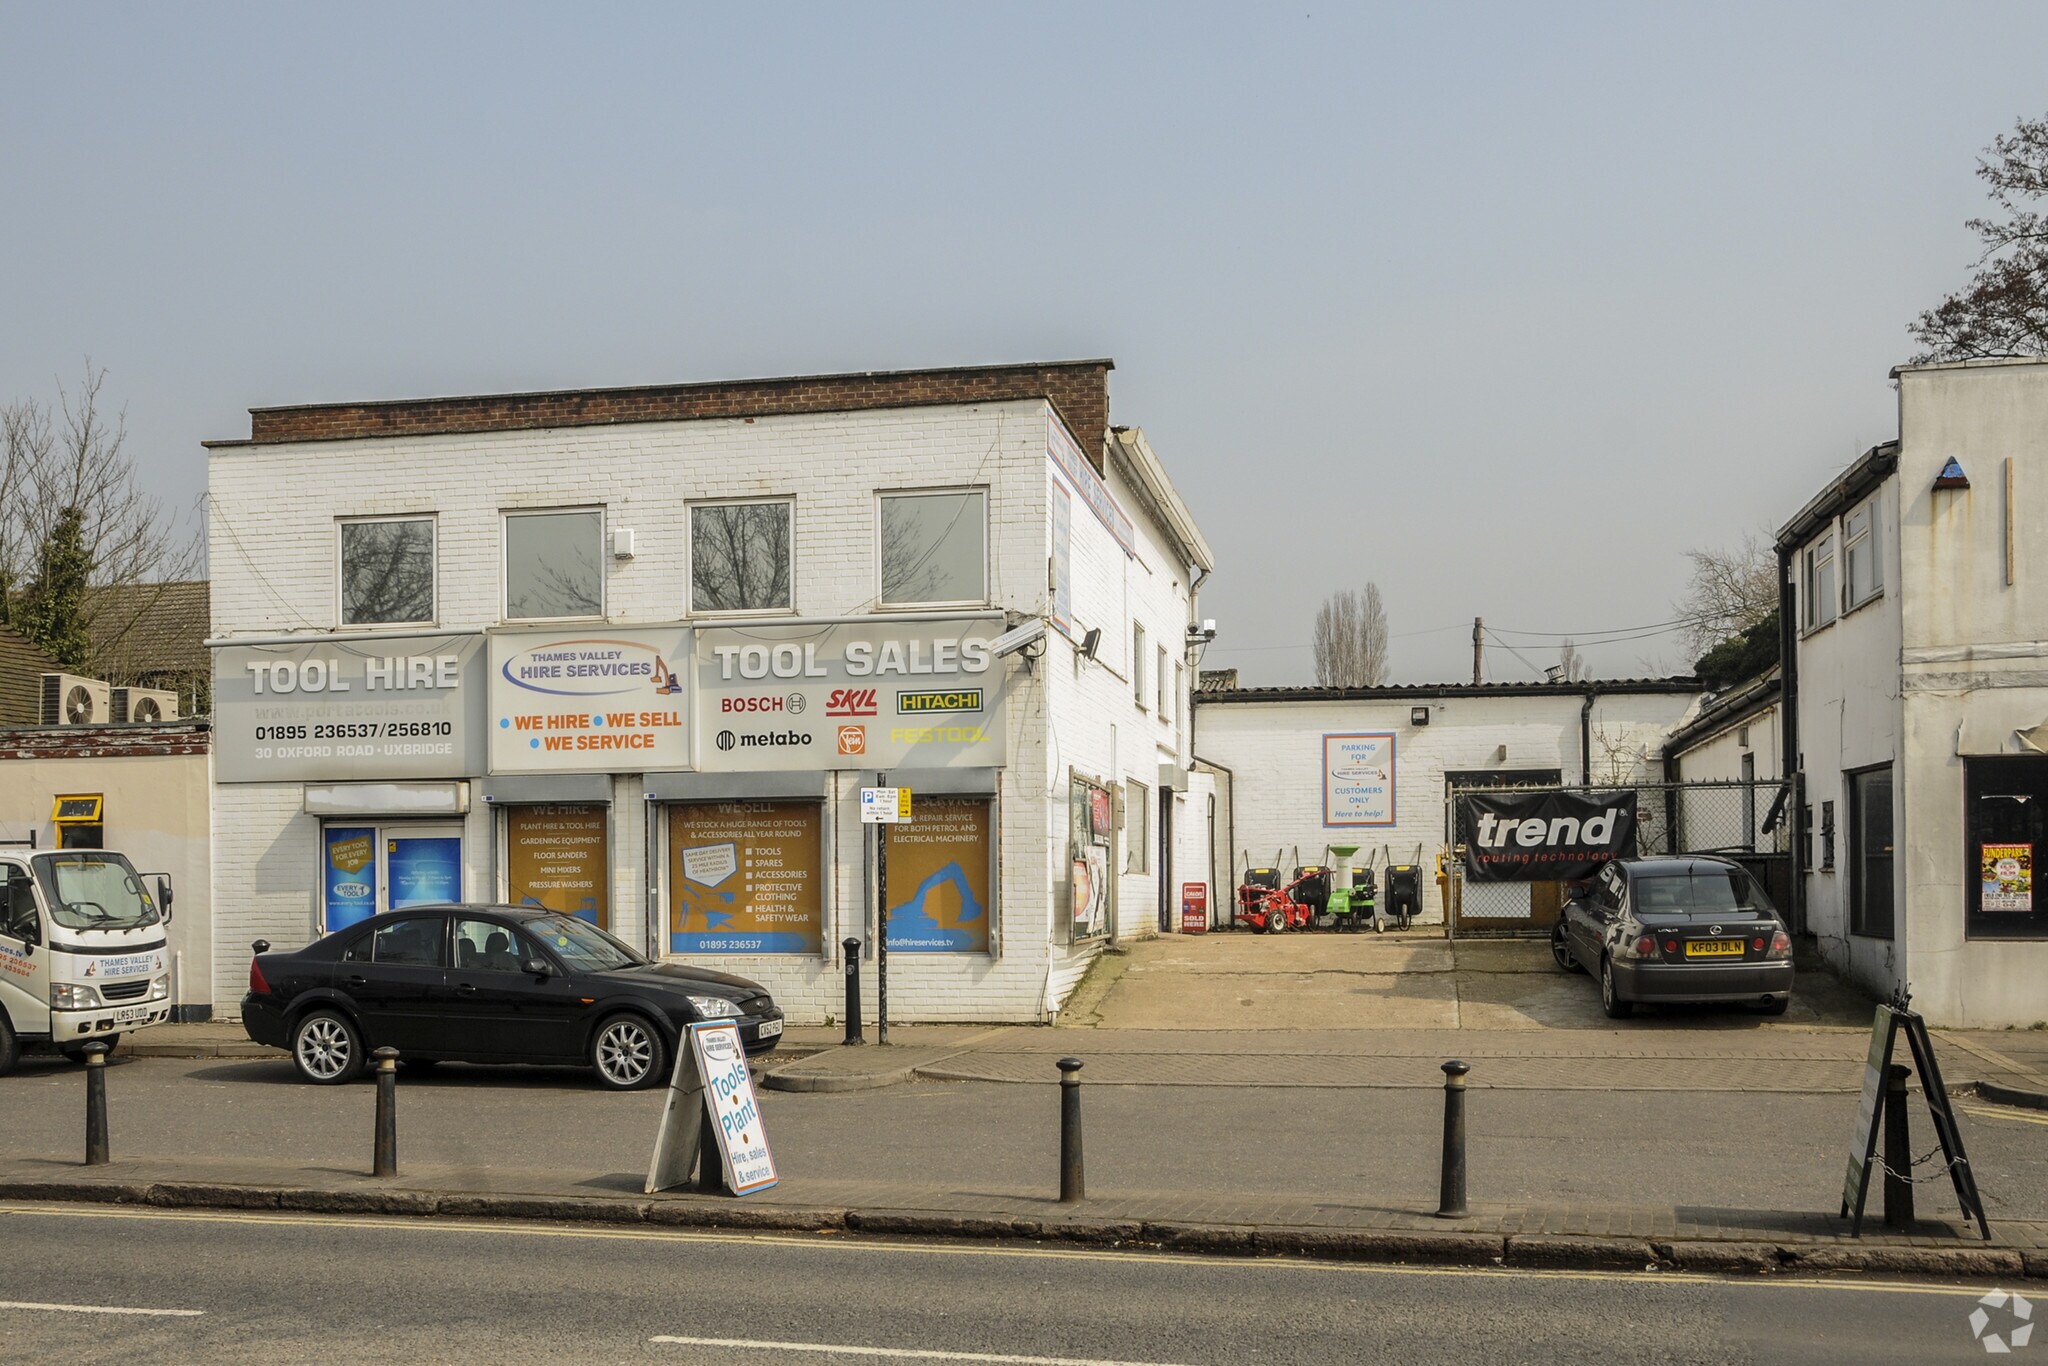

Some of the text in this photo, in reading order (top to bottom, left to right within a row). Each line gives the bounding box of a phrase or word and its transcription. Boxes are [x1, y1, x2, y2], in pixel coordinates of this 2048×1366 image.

[531, 651, 622, 663] THAMES VALLEY
[715, 637, 990, 680] TOOL SALES
[247, 654, 459, 695] TOOL HIRE
[521, 662, 651, 679] HIRE SERVICES
[722, 696, 783, 713] BOSCH
[826, 688, 878, 712] SKIL
[902, 693, 978, 710] HITACHI
[515, 714, 590, 730] WE HIRE
[606, 711, 682, 728] WE SELL
[256, 721, 452, 740] 01895 236537/256810
[890, 726, 990, 744] FESTOOL
[544, 733, 655, 751] WE SERVICE
[740, 729, 812, 747] metabo
[255, 742, 453, 759] 30 OXFORD ROAD UXBRIDGE
[1351, 753, 1367, 761] FOR
[1334, 786, 1383, 795] CUSTOMERS
[1348, 796, 1370, 804] ONLY
[532, 806, 554, 815] WE
[718, 803, 775, 813] WE SELL
[919, 814, 944, 822] REPAIR
[944, 813, 973, 821] SERVICE
[1334, 810, 1353, 818] Here
[1363, 809, 1384, 819] help!
[559, 822, 565, 830] &
[566, 822, 584, 830] TOOL
[585, 821, 600, 829] HIRE
[684, 821, 696, 829] WE
[696, 821, 719, 829] STOCK
[726, 821, 747, 829] HUGE
[748, 820, 772, 828] RANGE
[773, 820, 783, 828] OF
[784, 819, 807, 828] TOOLS
[894, 823, 978, 833] FOR BOTH PETROL AND
[1477, 808, 1617, 848] trend
[690, 829, 802, 839] & ACCESSORIES ALL YEAR ROUND
[893, 834, 979, 843] ELECTRICAL MACHINERY
[520, 836, 601, 845] GARDENING EQUIPMENT
[332, 840, 369, 855] EVERY TOOL
[755, 847, 782, 856] TOOLS
[335, 848, 368, 861] FOR EVERY
[533, 851, 588, 859] FLOOR SANDERS
[1476, 850, 1617, 865] routing technology
[755, 859, 784, 868] SPARES
[540, 866, 581, 874] MINI MIXERS
[755, 870, 808, 880] ACCESSORIES
[336, 884, 358, 892] EVERY
[528, 880, 593, 889] PRESSURE WASHERS
[755, 883, 803, 892] PROTECTIVE
[755, 893, 797, 901] CLOTHING
[755, 905, 795, 913] HEALTH &
[755, 914, 809, 922] SAFETY WEAR
[699, 940, 762, 950] 01895 236537
[886, 938, 954, 947] info@hireservices.tv
[1691, 941, 1741, 953] KF03 DLN
[100, 954, 154, 967] THAMES VALLEY
[104, 964, 149, 976] HIRE SERVICES
[116, 1009, 134, 1021] LR53
[711, 1063, 747, 1101] Tools
[721, 1097, 756, 1140] Plant
[731, 1146, 767, 1165] Hire, sales
[738, 1166, 770, 1183] & service
